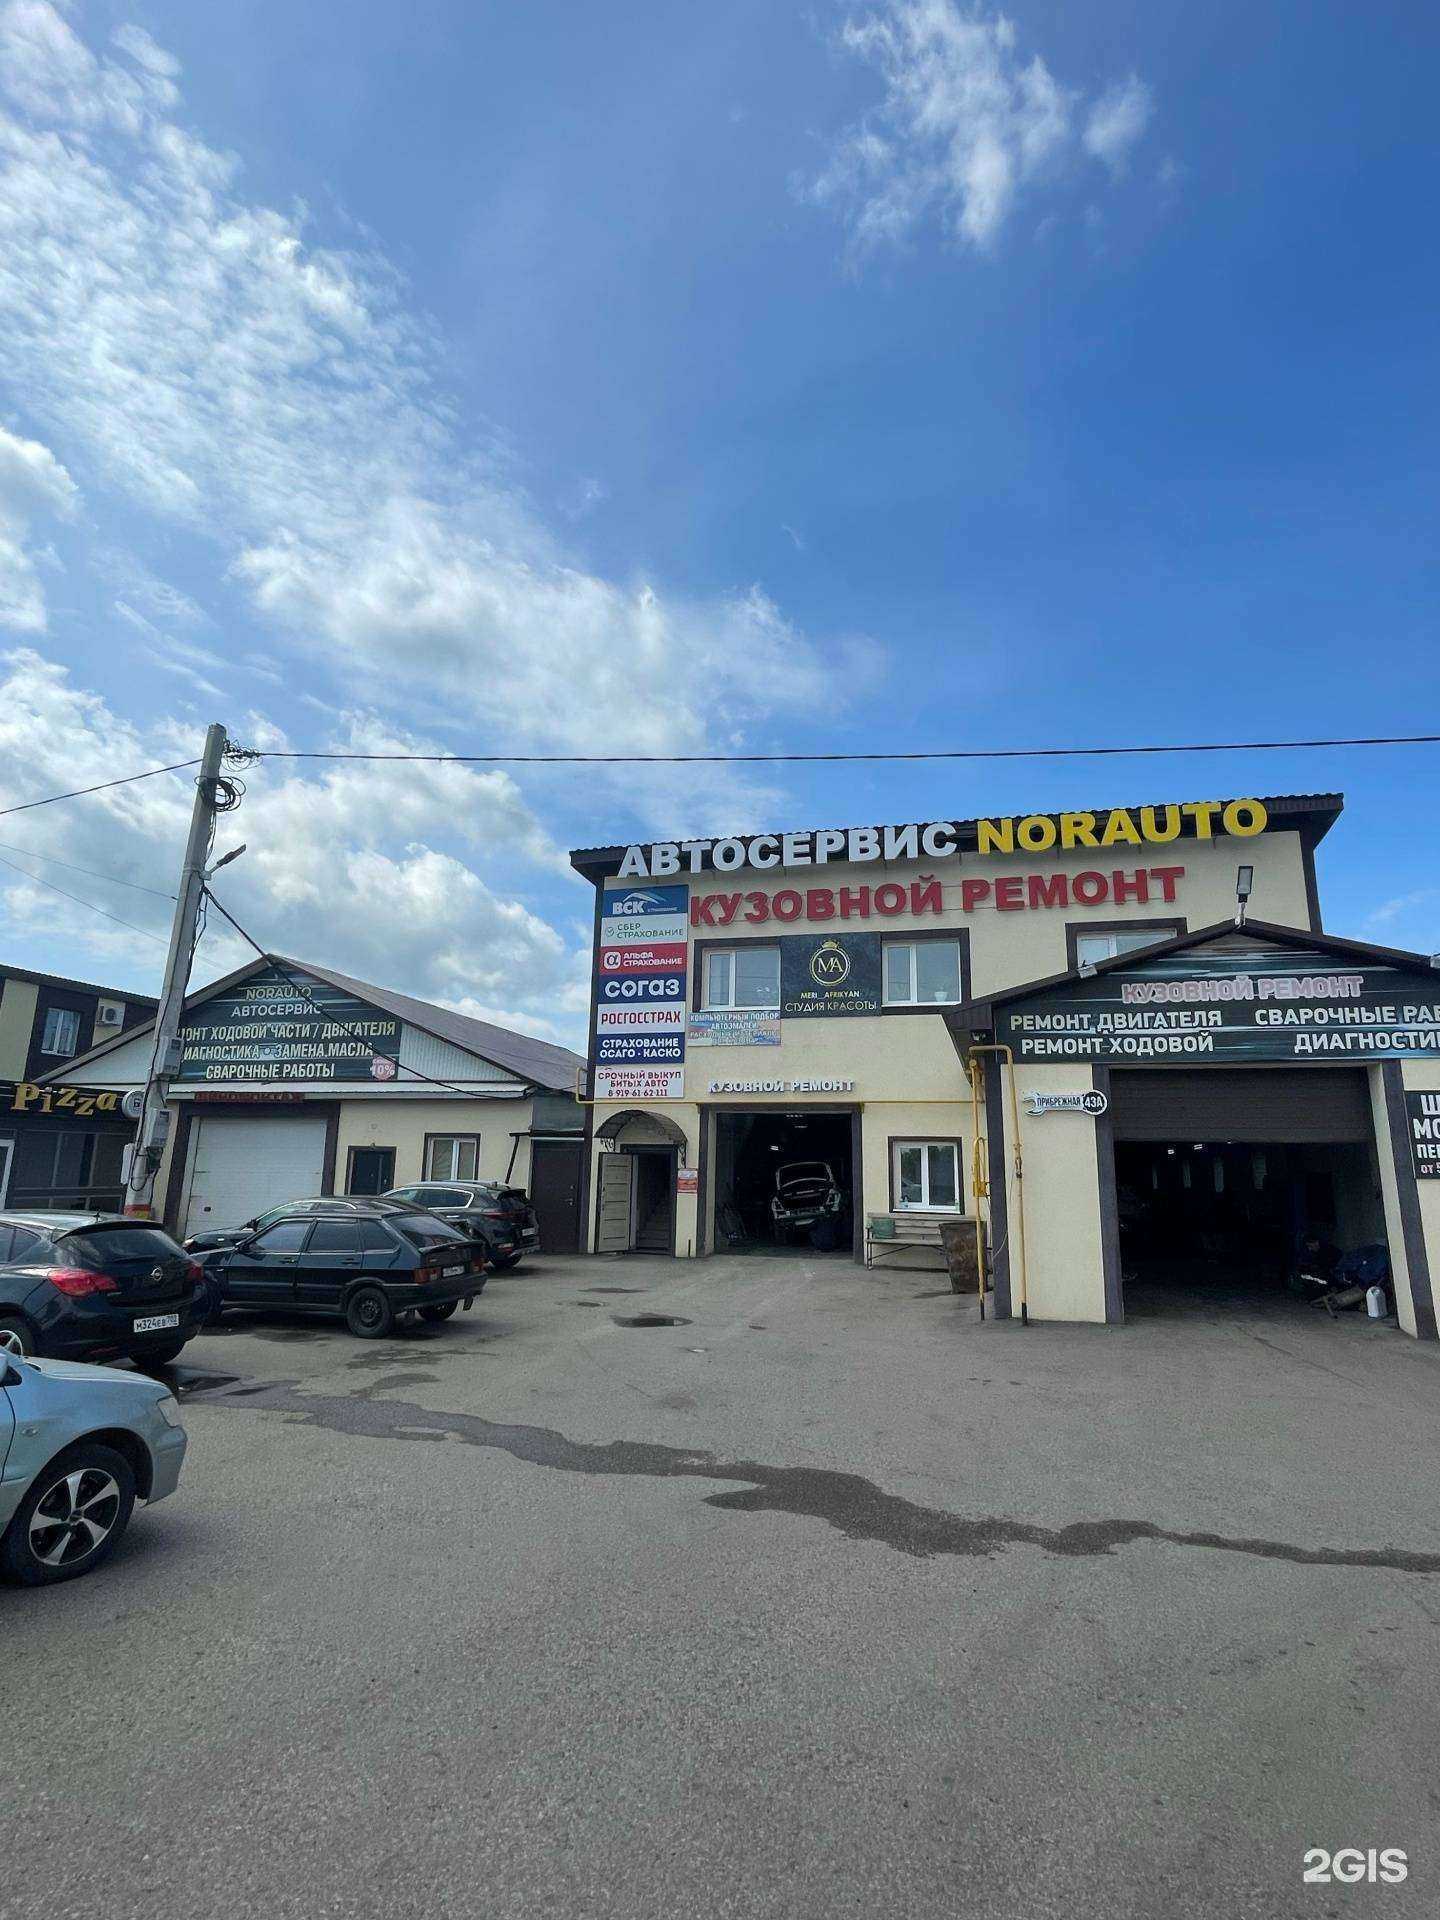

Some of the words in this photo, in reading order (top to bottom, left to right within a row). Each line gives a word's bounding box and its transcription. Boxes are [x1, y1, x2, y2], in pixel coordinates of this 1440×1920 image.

[616, 821, 957, 878] АВТОСЕРВИС
[977, 799, 1268, 854] NORAUTO
[690, 874, 943, 928] КУЗОВНОЙ
[961, 866, 1185, 912] РЕМОНТ
[612, 900, 645, 915] ВСК
[616, 928, 683, 939] СТРАХОВАНИЕ
[617, 923, 641, 931] СБЕР
[623, 952, 653, 960] АЛЬФА
[623, 957, 683, 967] СТРАХОВАНИЕ
[246, 984, 313, 1000] NORAUTO
[1121, 975, 1254, 1003] КУЗОВНОЙ
[1258, 976, 1364, 1000] РЕМОНТ
[231, 1003, 323, 1017] АВТОСЕРВИС
[785, 1002, 825, 1012] СТУДИЯ
[827, 1000, 877, 1012] КРАСОТЫ
[601, 1011, 680, 1024] РОСГОССТРАХ
[1010, 1013, 1092, 1031] РЕМОНТ
[1096, 1010, 1223, 1032] ДВИГАТЕЛЯ
[1254, 1006, 1397, 1026] СВАРОЧНЫЕ
[210, 1023, 266, 1043] ХОДОВОЙ
[271, 1023, 309, 1038] ЧАСТИ
[321, 1021, 395, 1040] ДВИГАТЕЛЯ
[602, 1038, 679, 1048] СТРАХОВАНИЕ
[1022, 1038, 1102, 1054] РЕМОНТ
[1109, 1031, 1214, 1055] ХОДОВОЙ
[181, 1045, 259, 1063] ИАГНОСТИКА
[275, 1043, 327, 1058] ЗАМЕНА
[329, 1042, 373, 1056] МАСЛА
[600, 1049, 636, 1058] ОСАГО
[643, 1048, 681, 1058] КАСКО
[206, 1065, 278, 1079] СВАРОЧНЫЕ
[283, 1063, 335, 1078] РАБОТЫ
[598, 1070, 645, 1080] СРОЧНЫЙ
[648, 1071, 681, 1079] ВЫКУП
[644, 1079, 669, 1087] АВТО
[708, 1080, 785, 1093] КУЗОВНОЙ
[791, 1080, 853, 1092] РЕМОНТ
[10, 1083, 118, 1115] Pizza
[616, 1089, 630, 1097] 919
[643, 1089, 654, 1097] 62
[1037, 1098, 1080, 1106] ПРИБРЕЖНАЯ
[1085, 1097, 1103, 1107] 43А
[1421, 1165, 1433, 1173] ОТ
